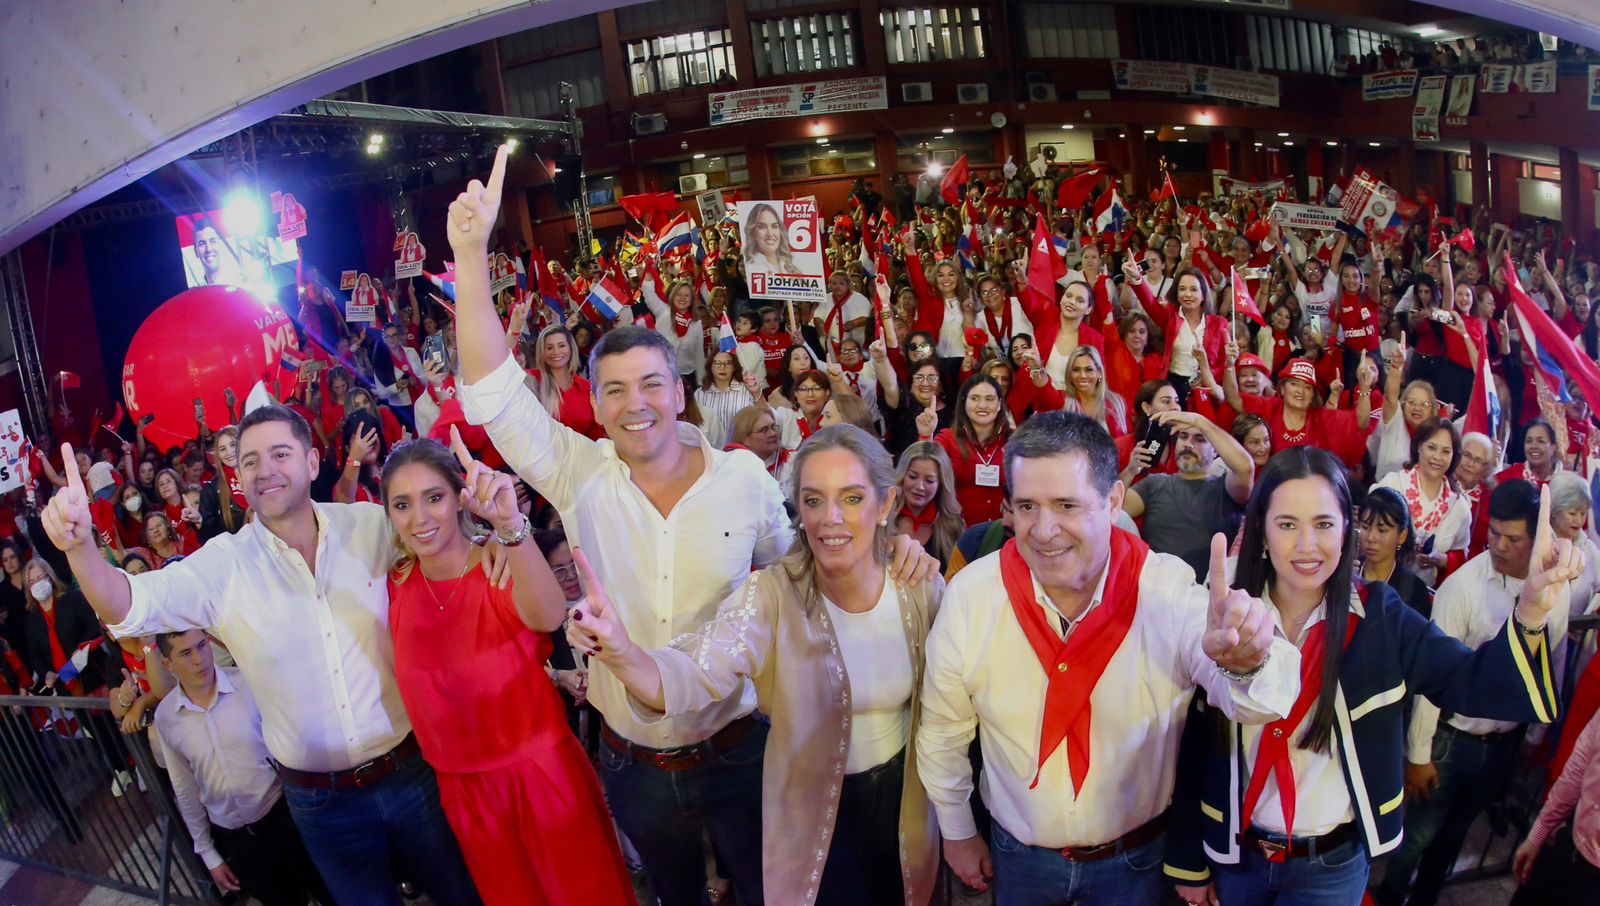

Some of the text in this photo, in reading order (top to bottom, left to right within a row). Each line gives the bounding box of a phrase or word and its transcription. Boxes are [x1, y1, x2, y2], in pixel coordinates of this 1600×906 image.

[712, 102, 724, 115] SP
[785, 201, 816, 212] VOTÁ
[788, 219, 811, 250] 6
[342, 277, 355, 287] 14
[753, 278, 819, 293] 1 JOHANA
